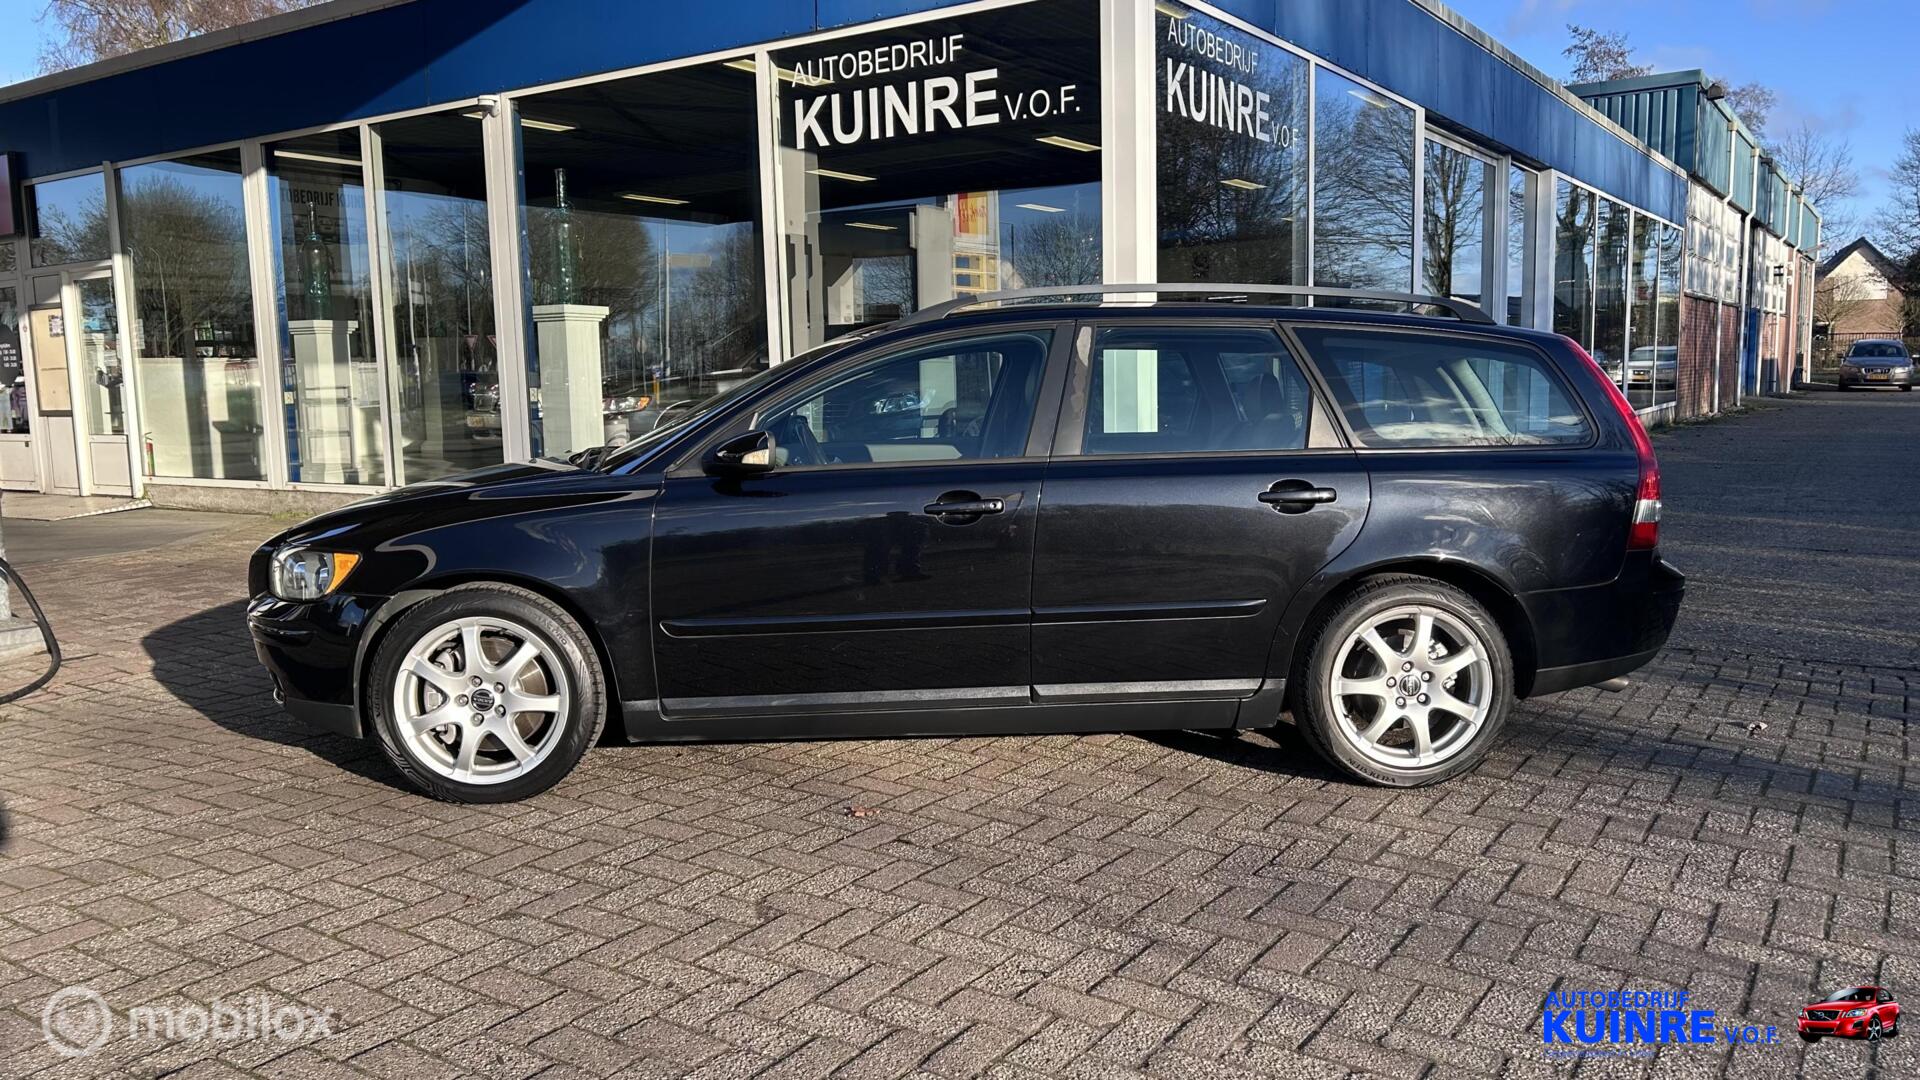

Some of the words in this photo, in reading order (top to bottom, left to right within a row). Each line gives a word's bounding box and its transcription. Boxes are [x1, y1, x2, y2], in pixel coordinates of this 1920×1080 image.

[793, 34, 964, 87] AUTOBEDRIJF
[1168, 17, 1258, 74] AUTOBEDRIJF
[794, 68, 1000, 149] KUINRE
[1004, 84, 1080, 120] V.O.F.
[1167, 58, 1270, 142] KUINRE
